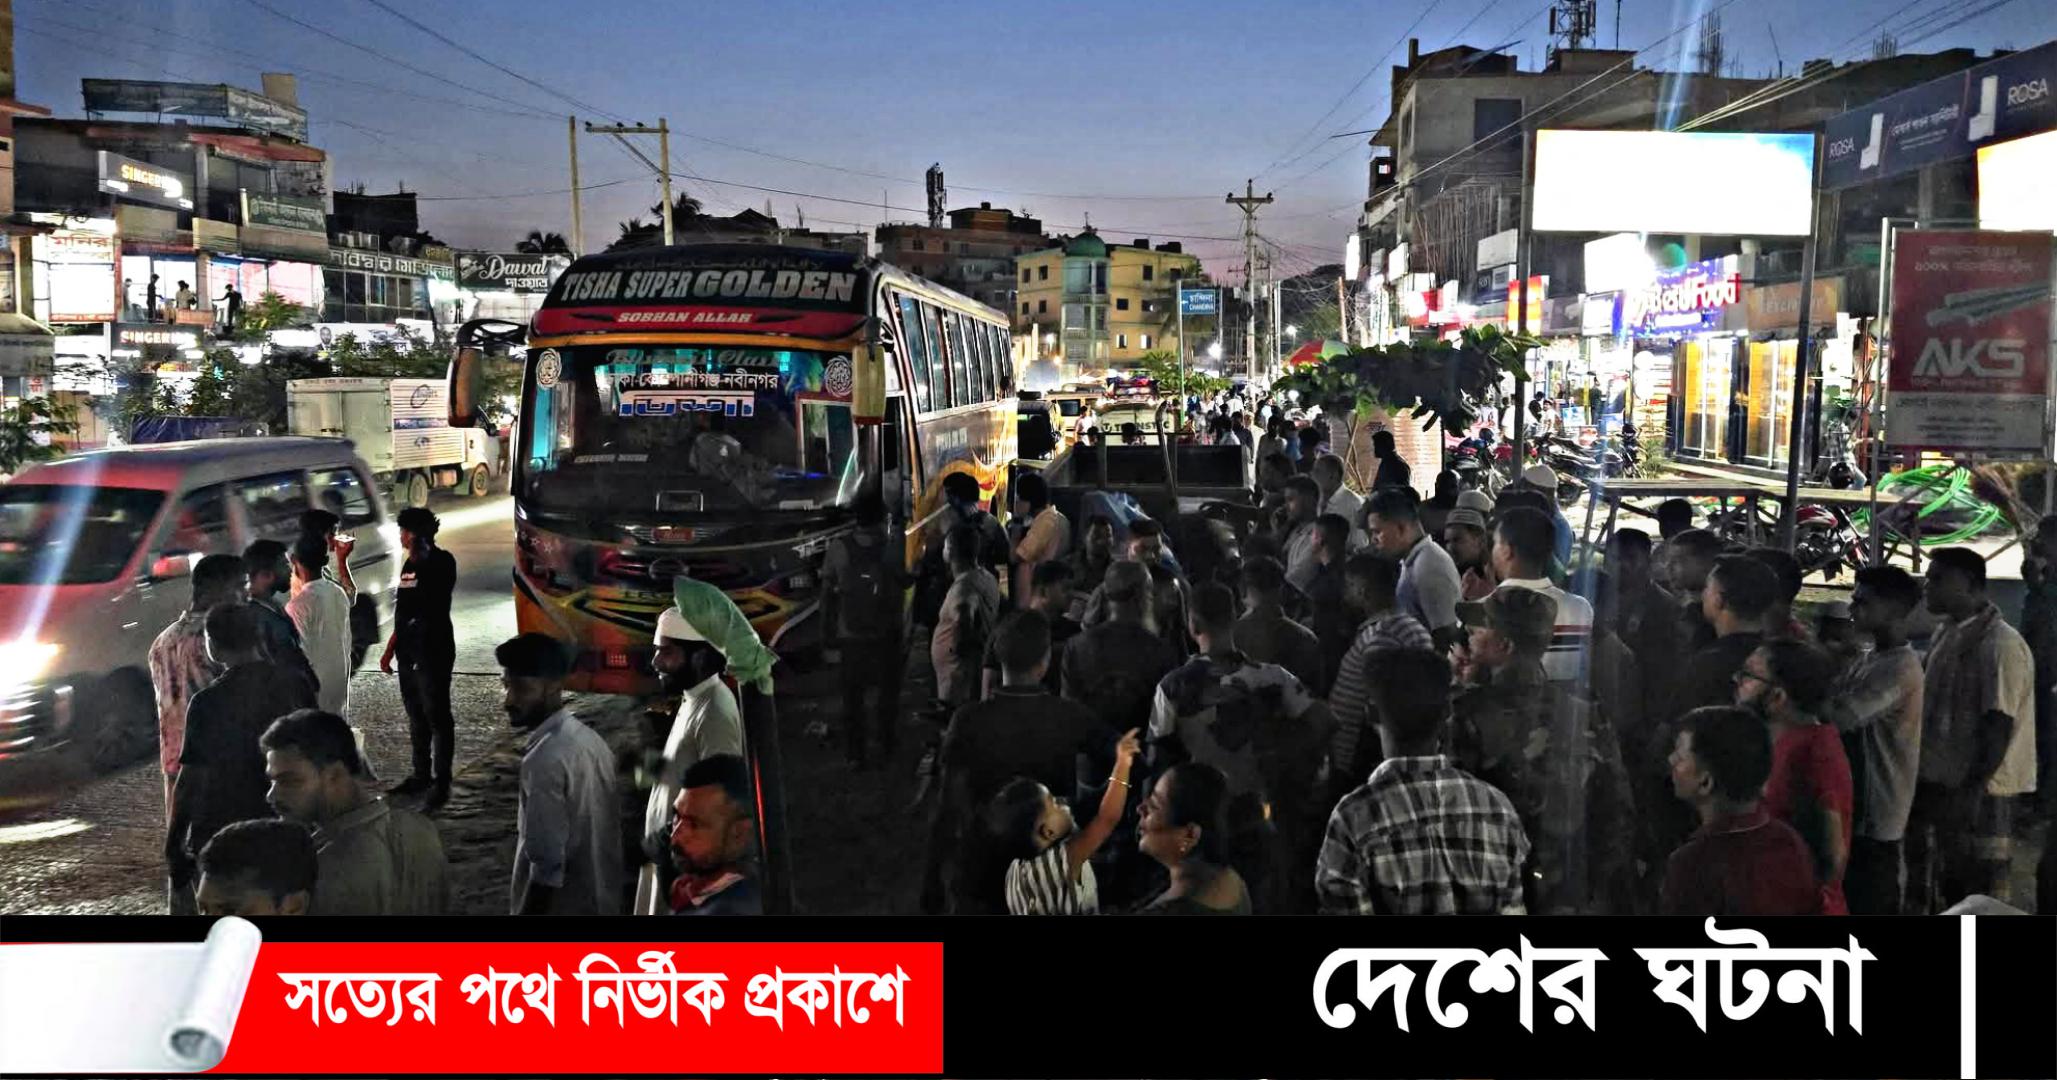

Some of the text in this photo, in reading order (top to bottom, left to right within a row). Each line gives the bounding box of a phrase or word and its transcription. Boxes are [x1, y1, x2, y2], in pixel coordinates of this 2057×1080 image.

[2007, 78, 2049, 107] ROSA
[1829, 137, 1855, 159] ROSA
[121, 164, 161, 188] SINGER
[560, 270, 857, 302] TISHA SUPER GOLDEN
[617, 312, 752, 323] SOBHAN ALLAH
[120, 330, 170, 344] SINGER
[1912, 337, 2027, 378] AKS
